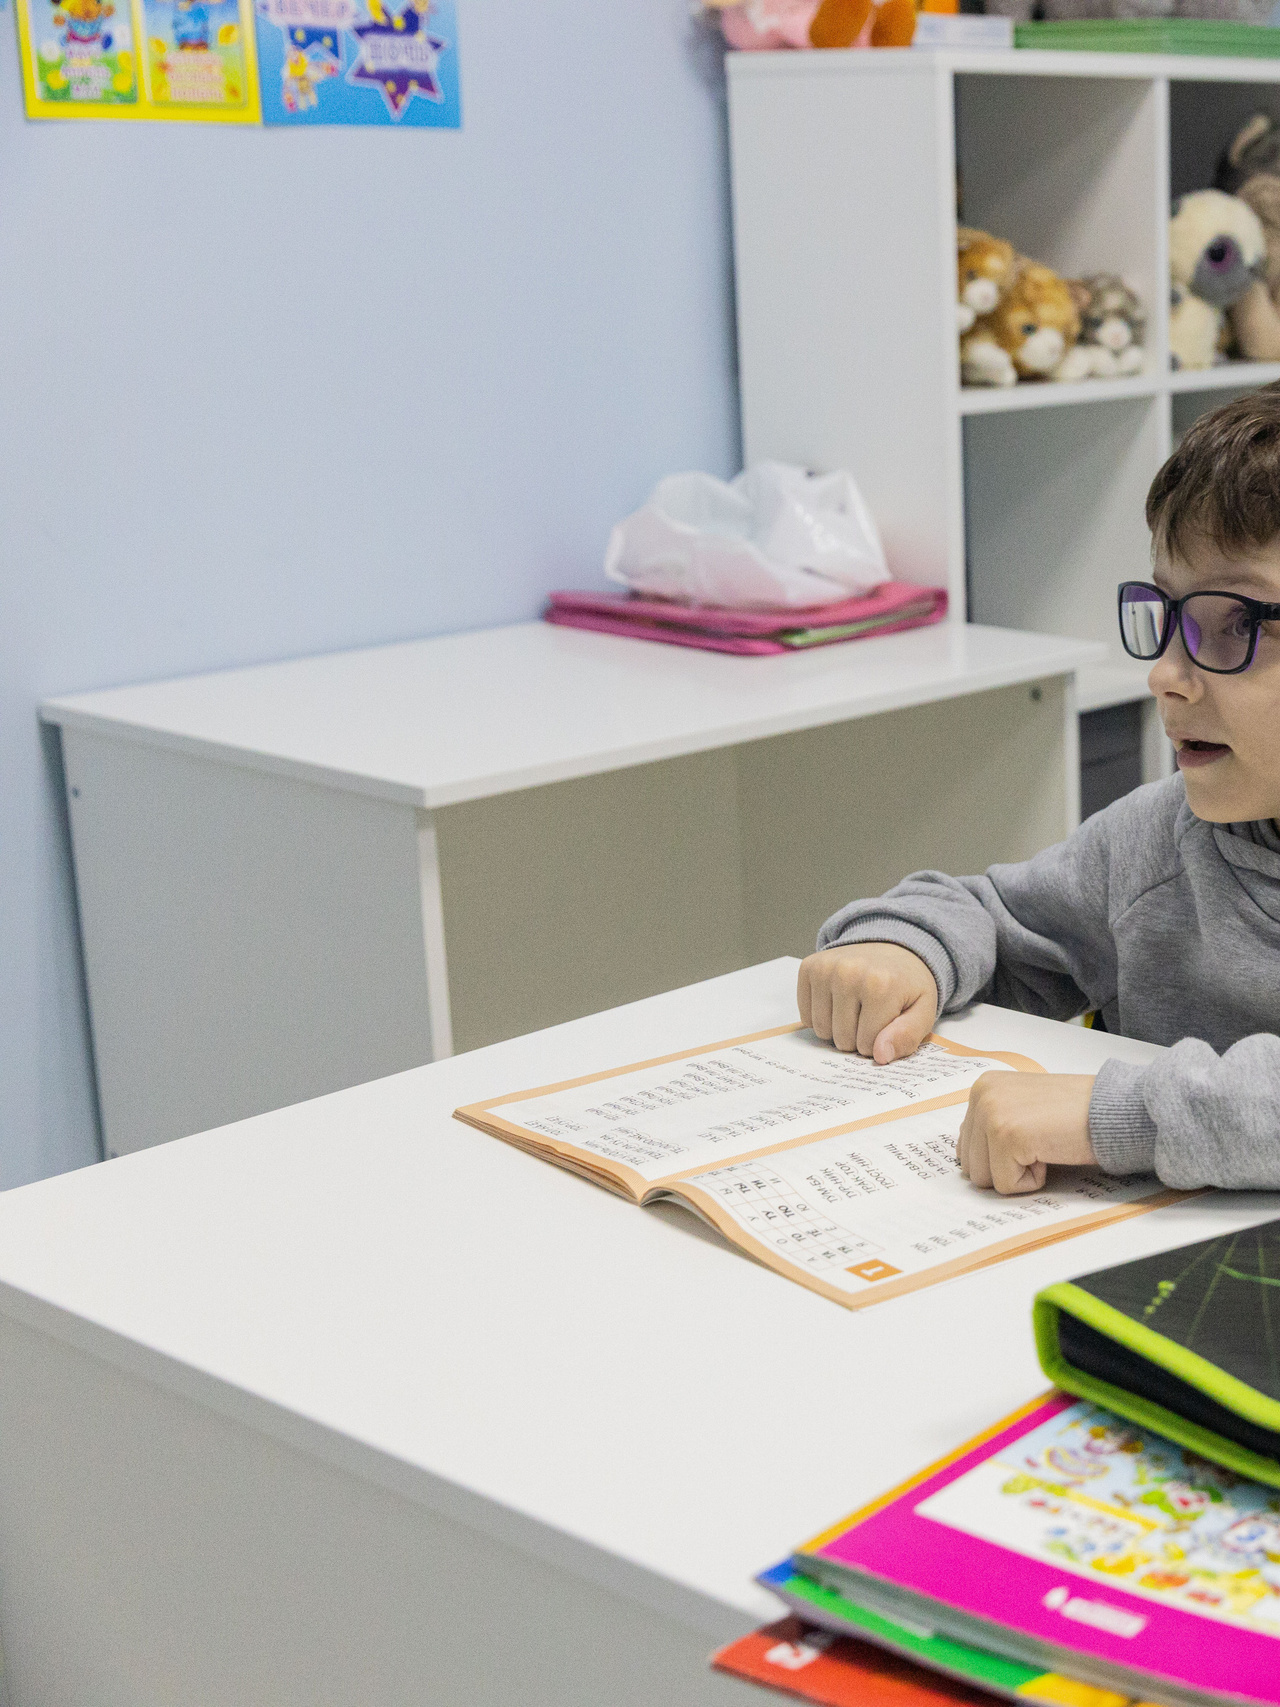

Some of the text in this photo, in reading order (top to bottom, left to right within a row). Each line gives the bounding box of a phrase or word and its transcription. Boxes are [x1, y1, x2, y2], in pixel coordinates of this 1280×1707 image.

[734, 1182, 751, 1194] ТЫ
[751, 1179, 767, 1189] ТИ
[761, 1209, 777, 1221] ТУ
[778, 1204, 795, 1218] ТЮ
[791, 1233, 807, 1242] ТО
[821, 1251, 836, 1259] ТА
[861, 1266, 884, 1276] Т
